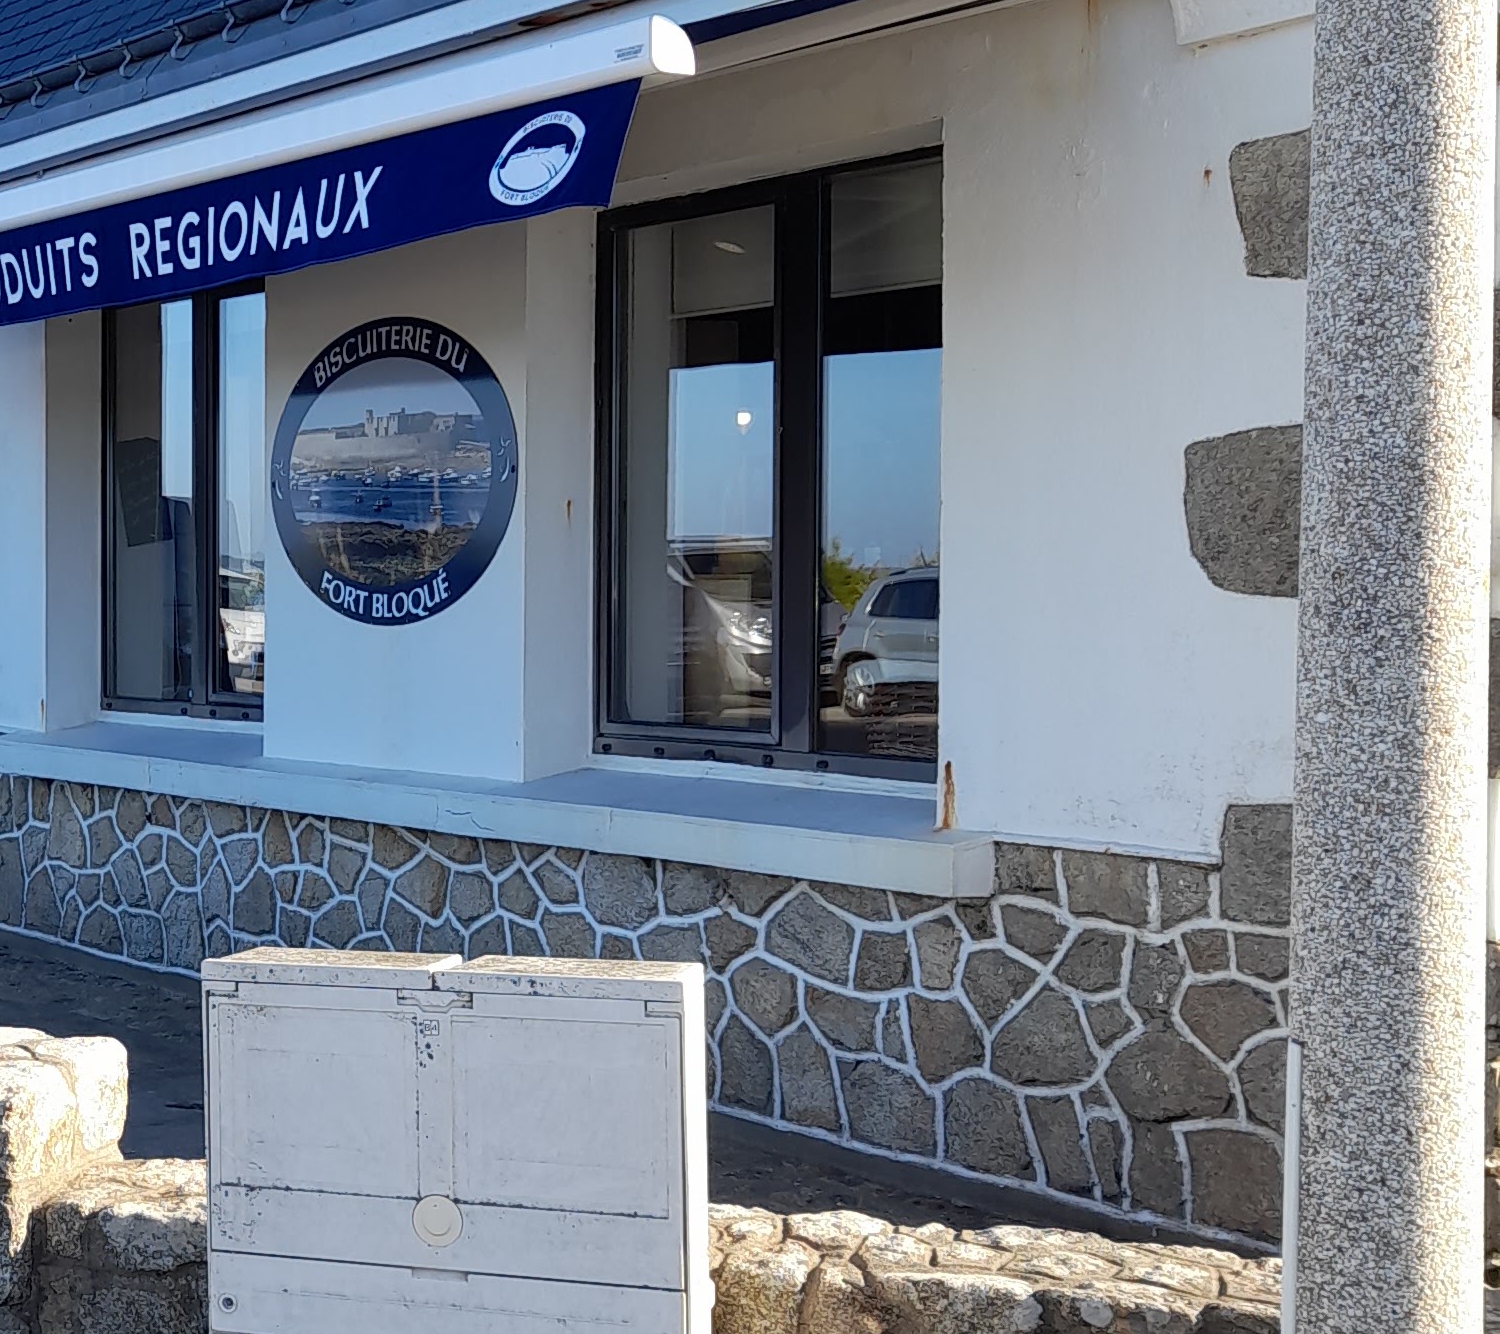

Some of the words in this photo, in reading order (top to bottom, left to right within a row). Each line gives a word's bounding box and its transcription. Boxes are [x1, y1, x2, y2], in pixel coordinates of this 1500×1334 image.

[129, 166, 383, 280] REGIONAUX
[313, 324, 433, 388] BISCUITERIE
[435, 333, 470, 373] DU
[320, 570, 368, 615] FORT
[372, 569, 451, 617] BLOQUÉ
